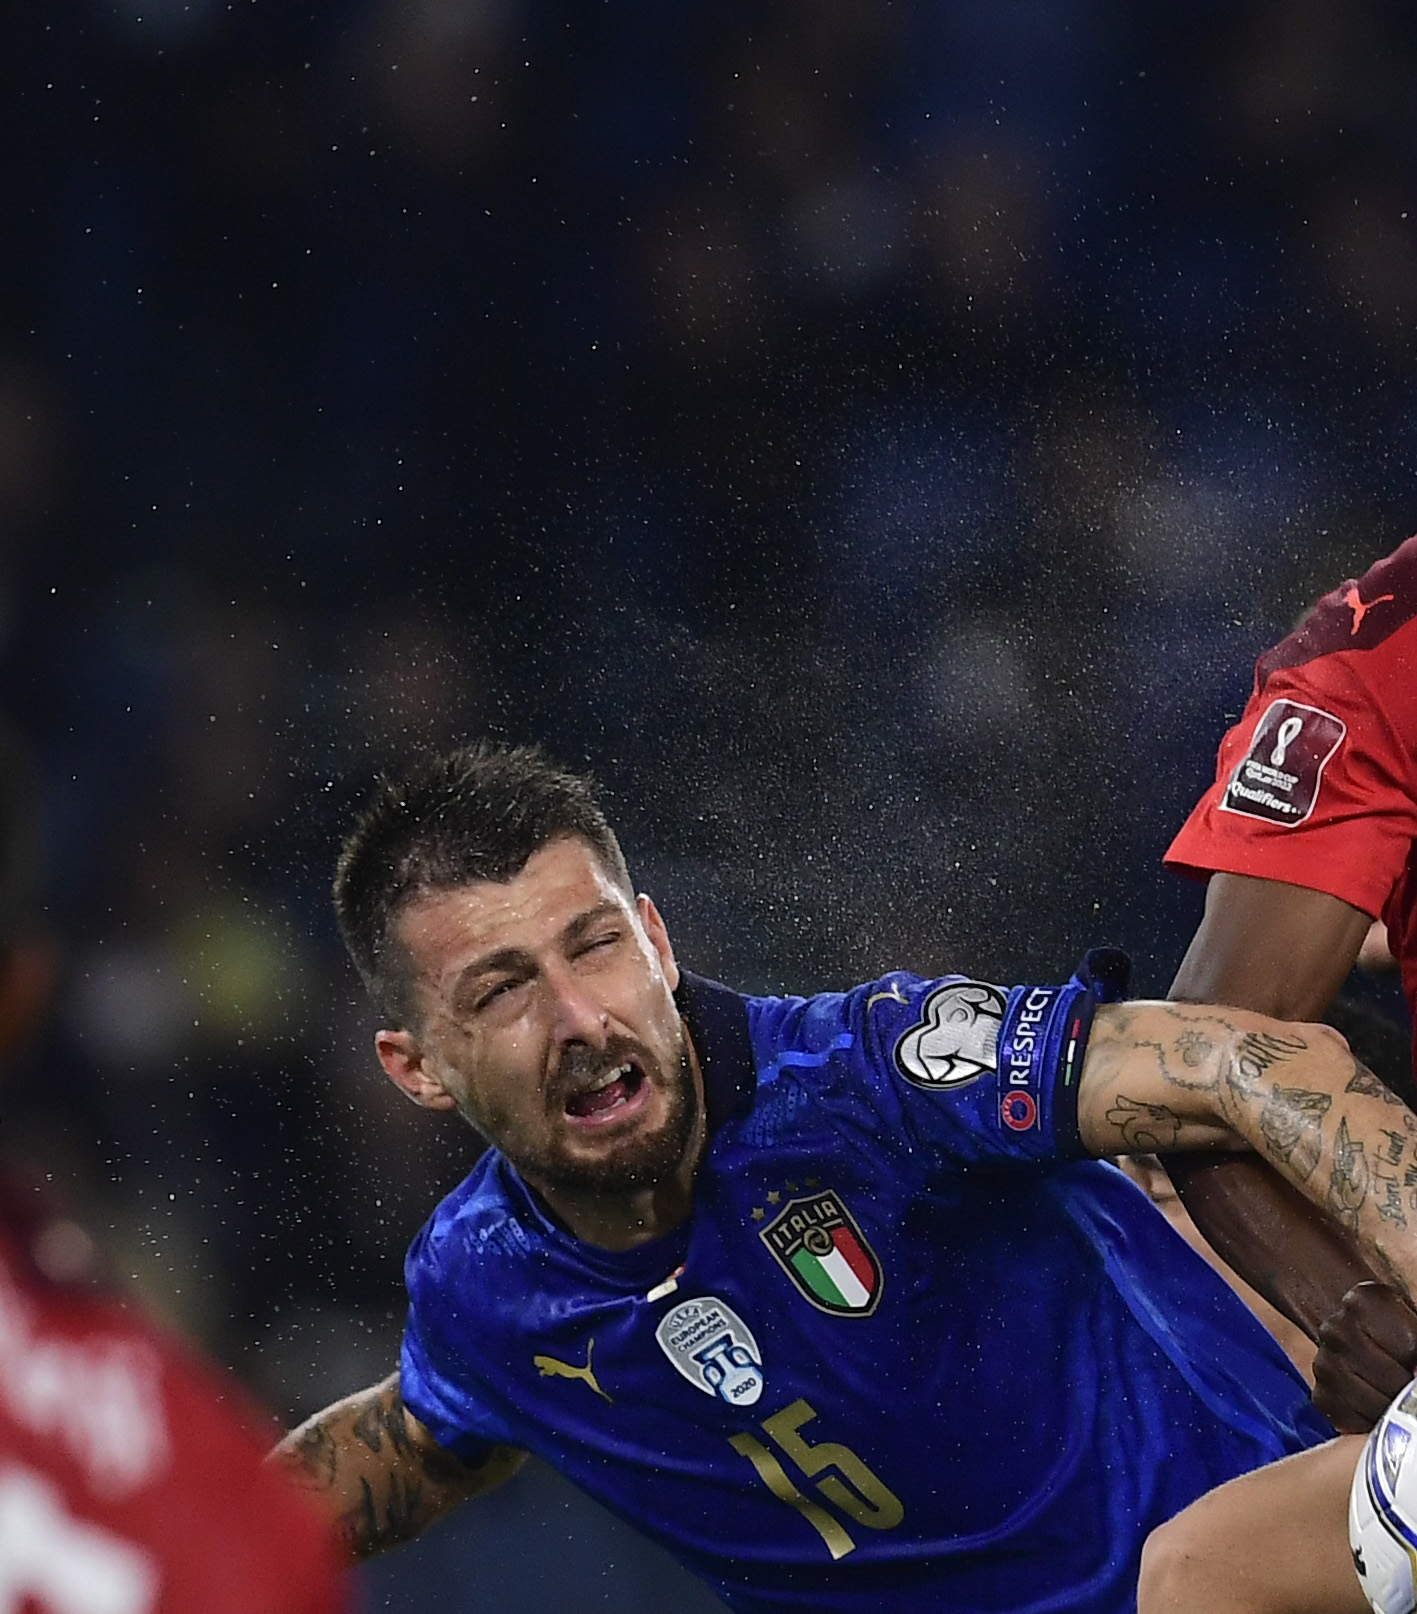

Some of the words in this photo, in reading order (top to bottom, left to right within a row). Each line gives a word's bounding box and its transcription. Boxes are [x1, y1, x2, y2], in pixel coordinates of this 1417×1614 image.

[1009, 987, 1053, 1085] RESPECT
[772, 1201, 839, 1248] ITALIA
[671, 1310, 720, 1345] EUROPEAN
[678, 1318, 727, 1352] CHAMPIONS
[730, 1377, 757, 1398] 2020
[728, 1398, 904, 1560] 15
